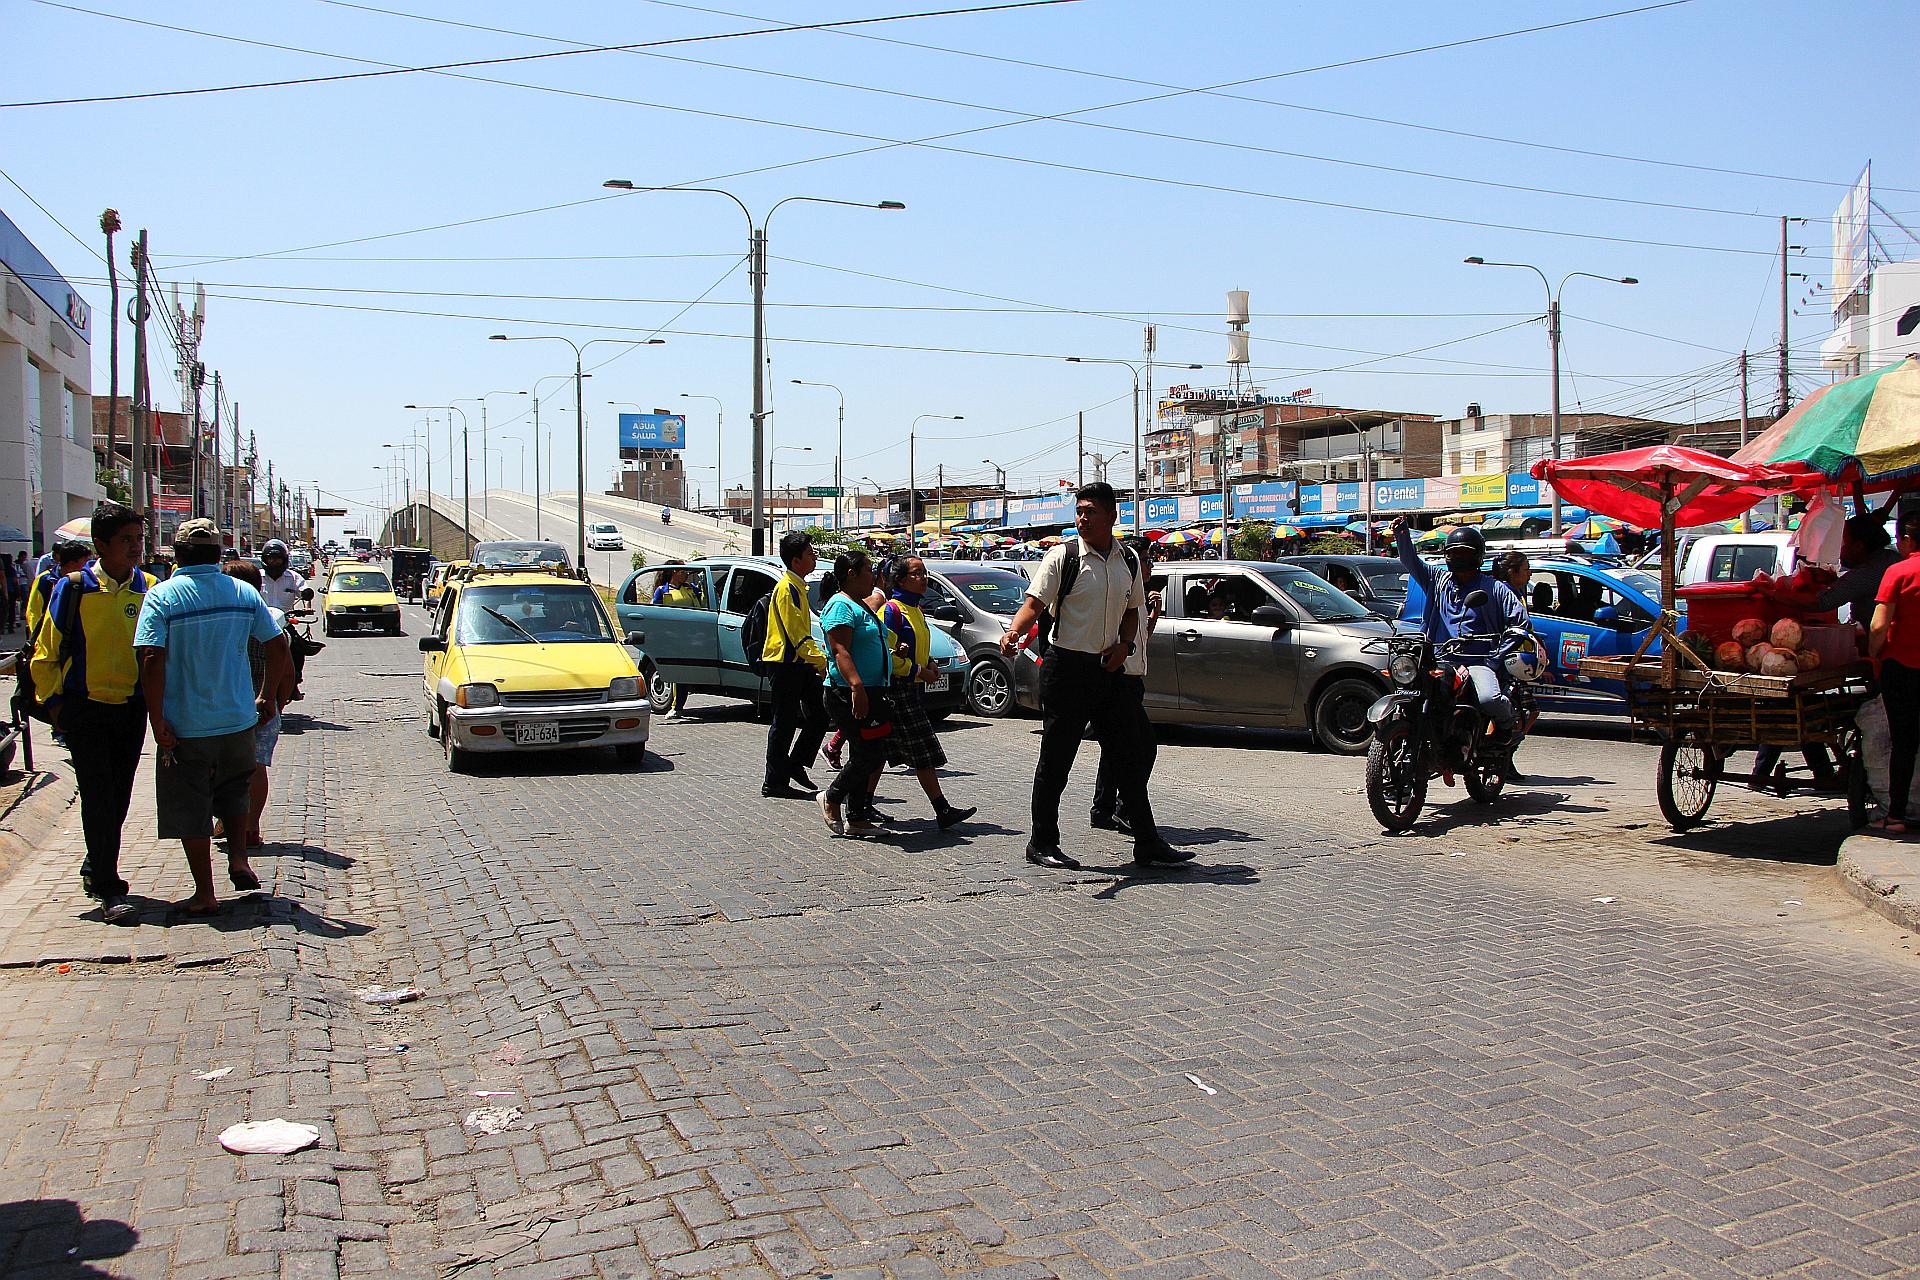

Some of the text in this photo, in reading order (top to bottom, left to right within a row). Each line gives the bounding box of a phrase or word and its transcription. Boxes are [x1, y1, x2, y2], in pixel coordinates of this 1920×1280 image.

[632, 422, 656, 430] AGUA
[631, 432, 657, 440] SALUD
[1468, 483, 1484, 494] bitel
[1520, 483, 1536, 493] entel
[1309, 493, 1320, 502] entel
[1345, 492, 1357, 500] entel
[1393, 486, 1418, 500] entel
[1258, 494, 1287, 502] COMERCIAL
[1159, 503, 1175, 515] entel
[517, 727, 558, 742] P2J-634
